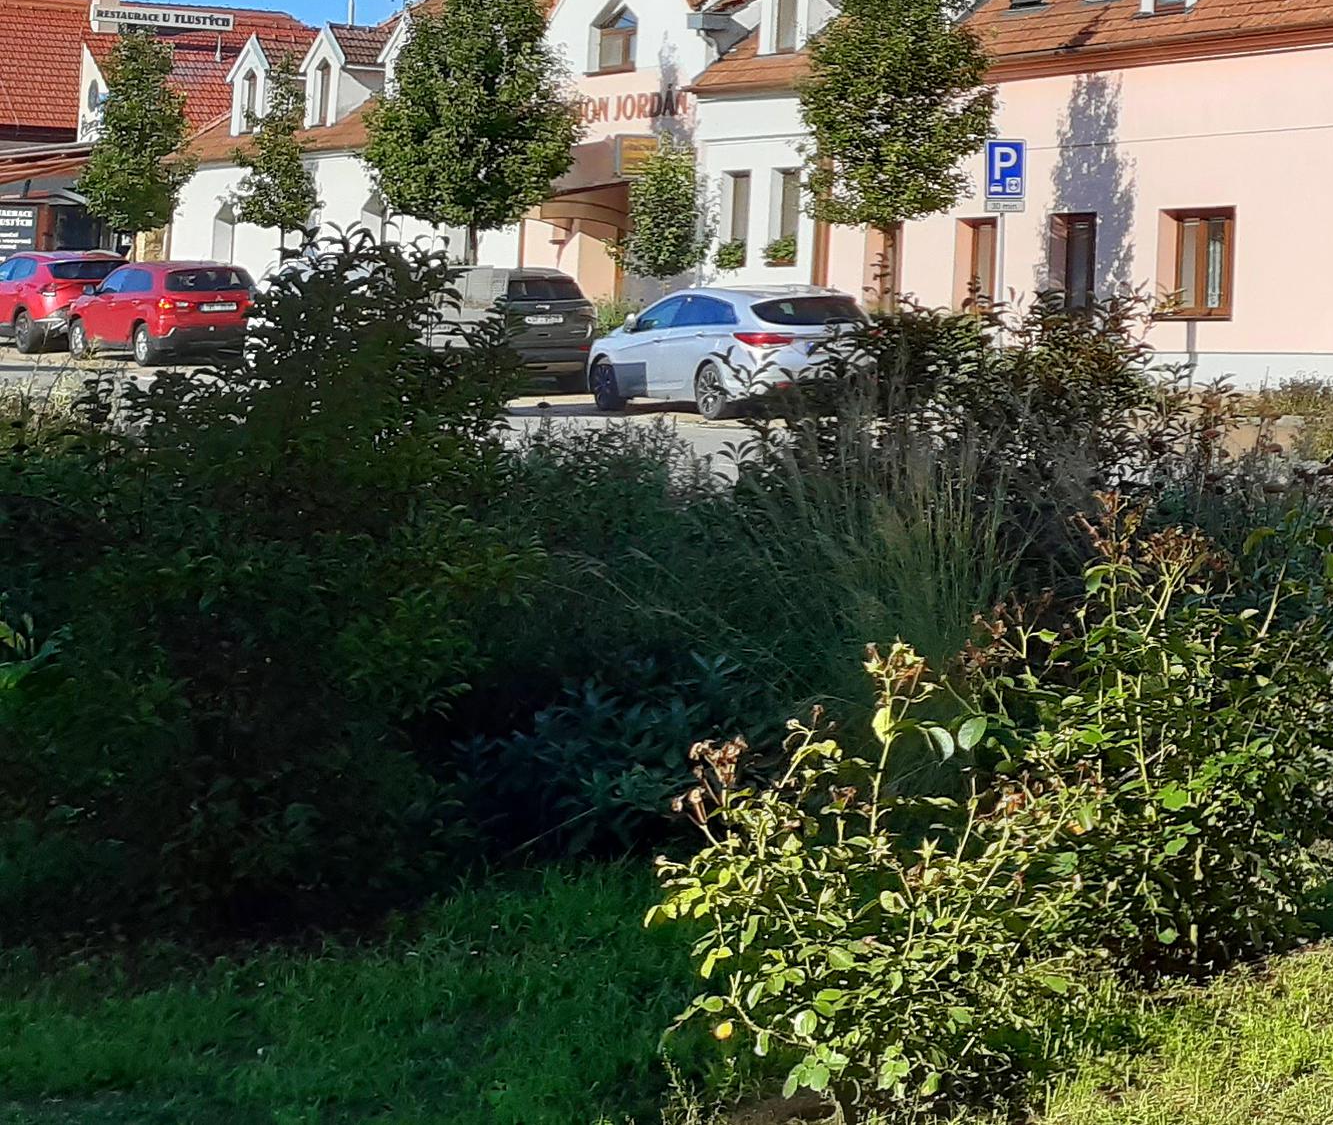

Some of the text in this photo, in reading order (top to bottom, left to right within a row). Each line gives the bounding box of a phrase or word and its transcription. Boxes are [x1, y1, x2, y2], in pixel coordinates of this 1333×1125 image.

[96, 9, 230, 27] RESTAURACE U TLUSTÝCH
[614, 83, 688, 121] JORDÁN
[994, 146, 1018, 180] P
